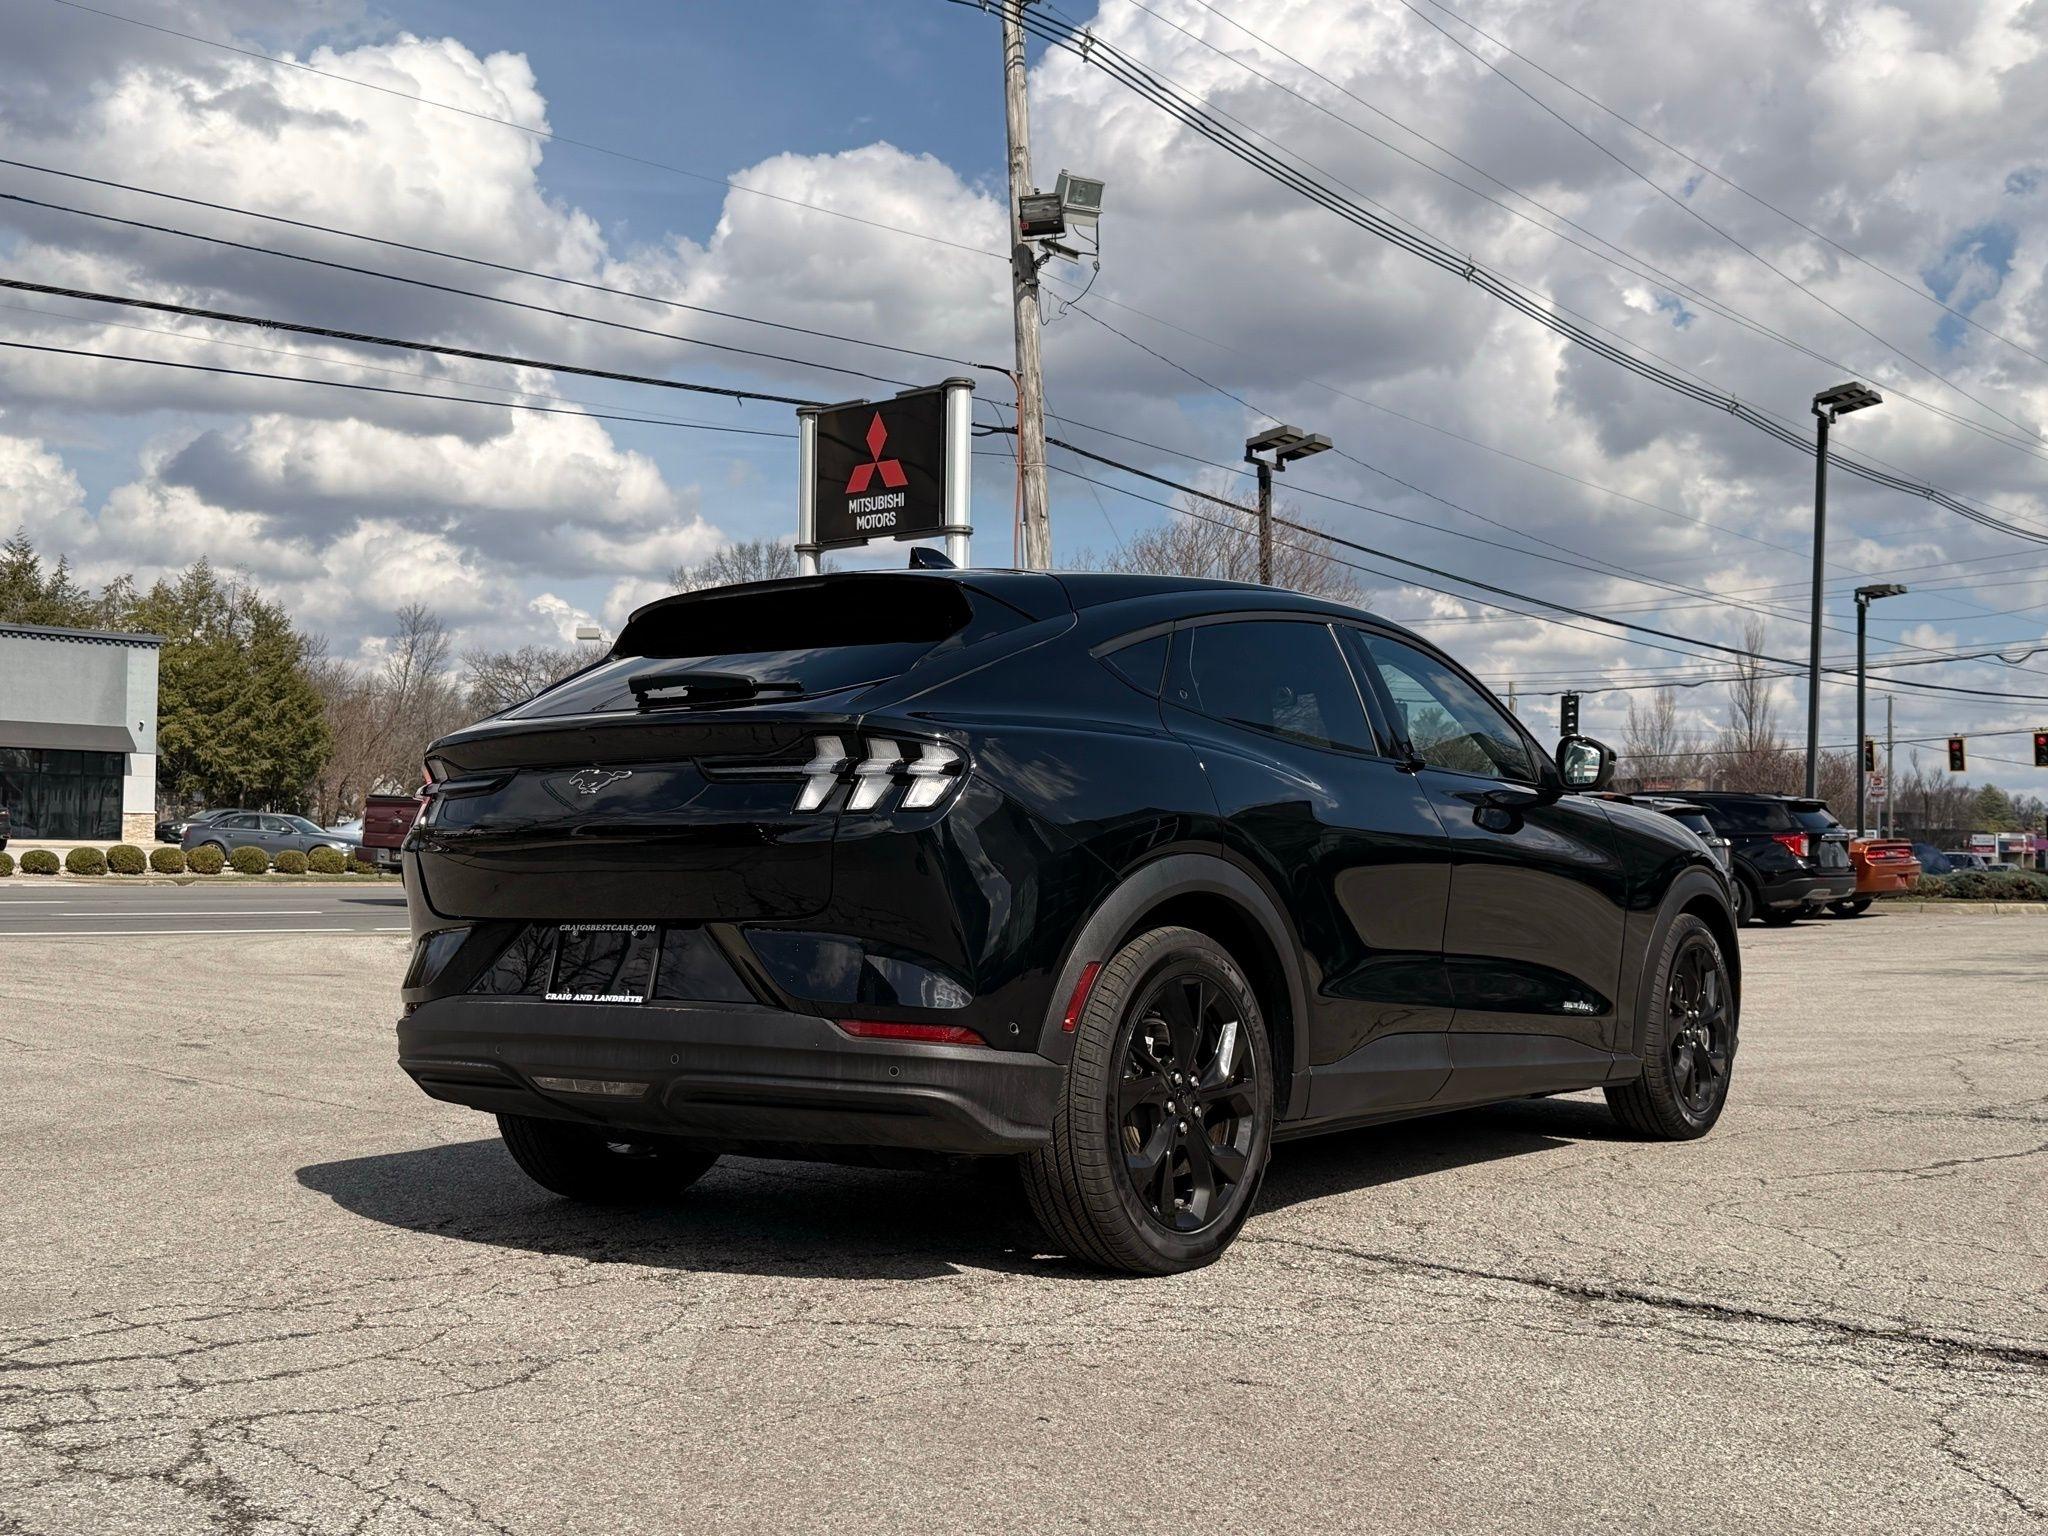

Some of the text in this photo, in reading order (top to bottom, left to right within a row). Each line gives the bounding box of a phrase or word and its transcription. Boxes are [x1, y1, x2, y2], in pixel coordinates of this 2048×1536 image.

[849, 492, 905, 514] MITSUBISHI
[857, 511, 896, 530] MOTORS
[559, 924, 656, 932] CRAIGSBESTCARS.COM
[545, 993, 643, 1003] CRAIG AND LANDRETH
